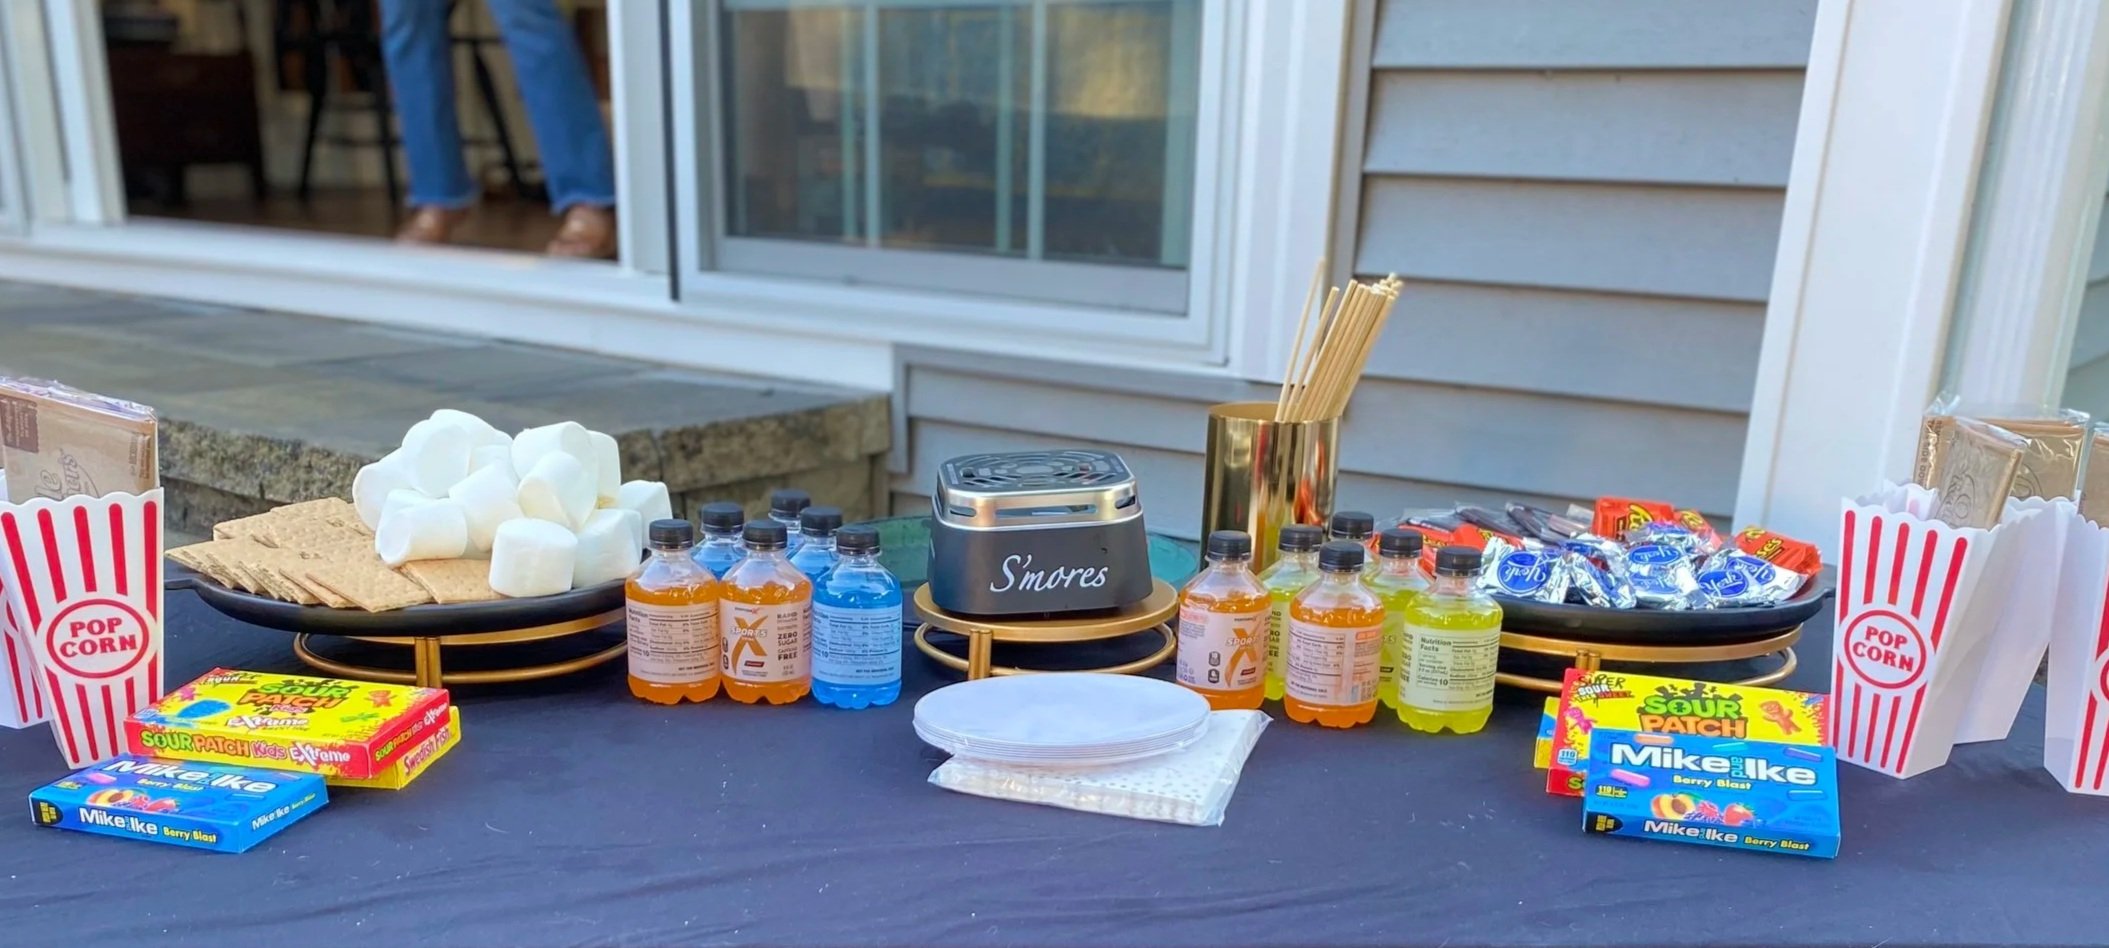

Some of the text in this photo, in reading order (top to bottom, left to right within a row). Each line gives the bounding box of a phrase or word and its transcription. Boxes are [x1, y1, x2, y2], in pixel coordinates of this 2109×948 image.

[990, 554, 1109, 592] S'mores
[1504, 556, 1547, 582] York
[1700, 572, 1743, 597] York
[70, 617, 122, 638] POP
[777, 631, 798, 640] ZERO
[1865, 625, 1908, 650] POP
[60, 634, 137, 657] CORN
[1420, 644, 1440, 652] Facts
[1421, 637, 1452, 646] Nutrition
[777, 652, 798, 661] FREE
[1853, 641, 1914, 672] CORN
[238, 692, 344, 708] PATCH
[257, 683, 350, 698] SOUR
[1578, 684, 1611, 696] SOUR
[1644, 695, 1741, 719] SOUR
[1639, 714, 1747, 738] PATCH
[141, 731, 193, 750] SOUR
[192, 734, 250, 757] PATCH
[251, 741, 287, 760] Kids
[1611, 743, 1730, 773] Mike
[1745, 758, 1816, 785] Ike
[103, 760, 277, 793] Mike Ike
[137, 778, 169, 788] Berry
[1673, 775, 1752, 790] Berry Blast
[78, 807, 126, 828] Mike
[131, 818, 158, 835] Ike
[163, 827, 192, 841] Berry
[192, 831, 217, 843] Blast
[251, 813, 275, 831] Mike
[1644, 820, 1700, 837] Mike
[1705, 828, 1738, 842] Ike
[1744, 837, 1777, 848] Berry
[1780, 840, 1810, 851] Blast
